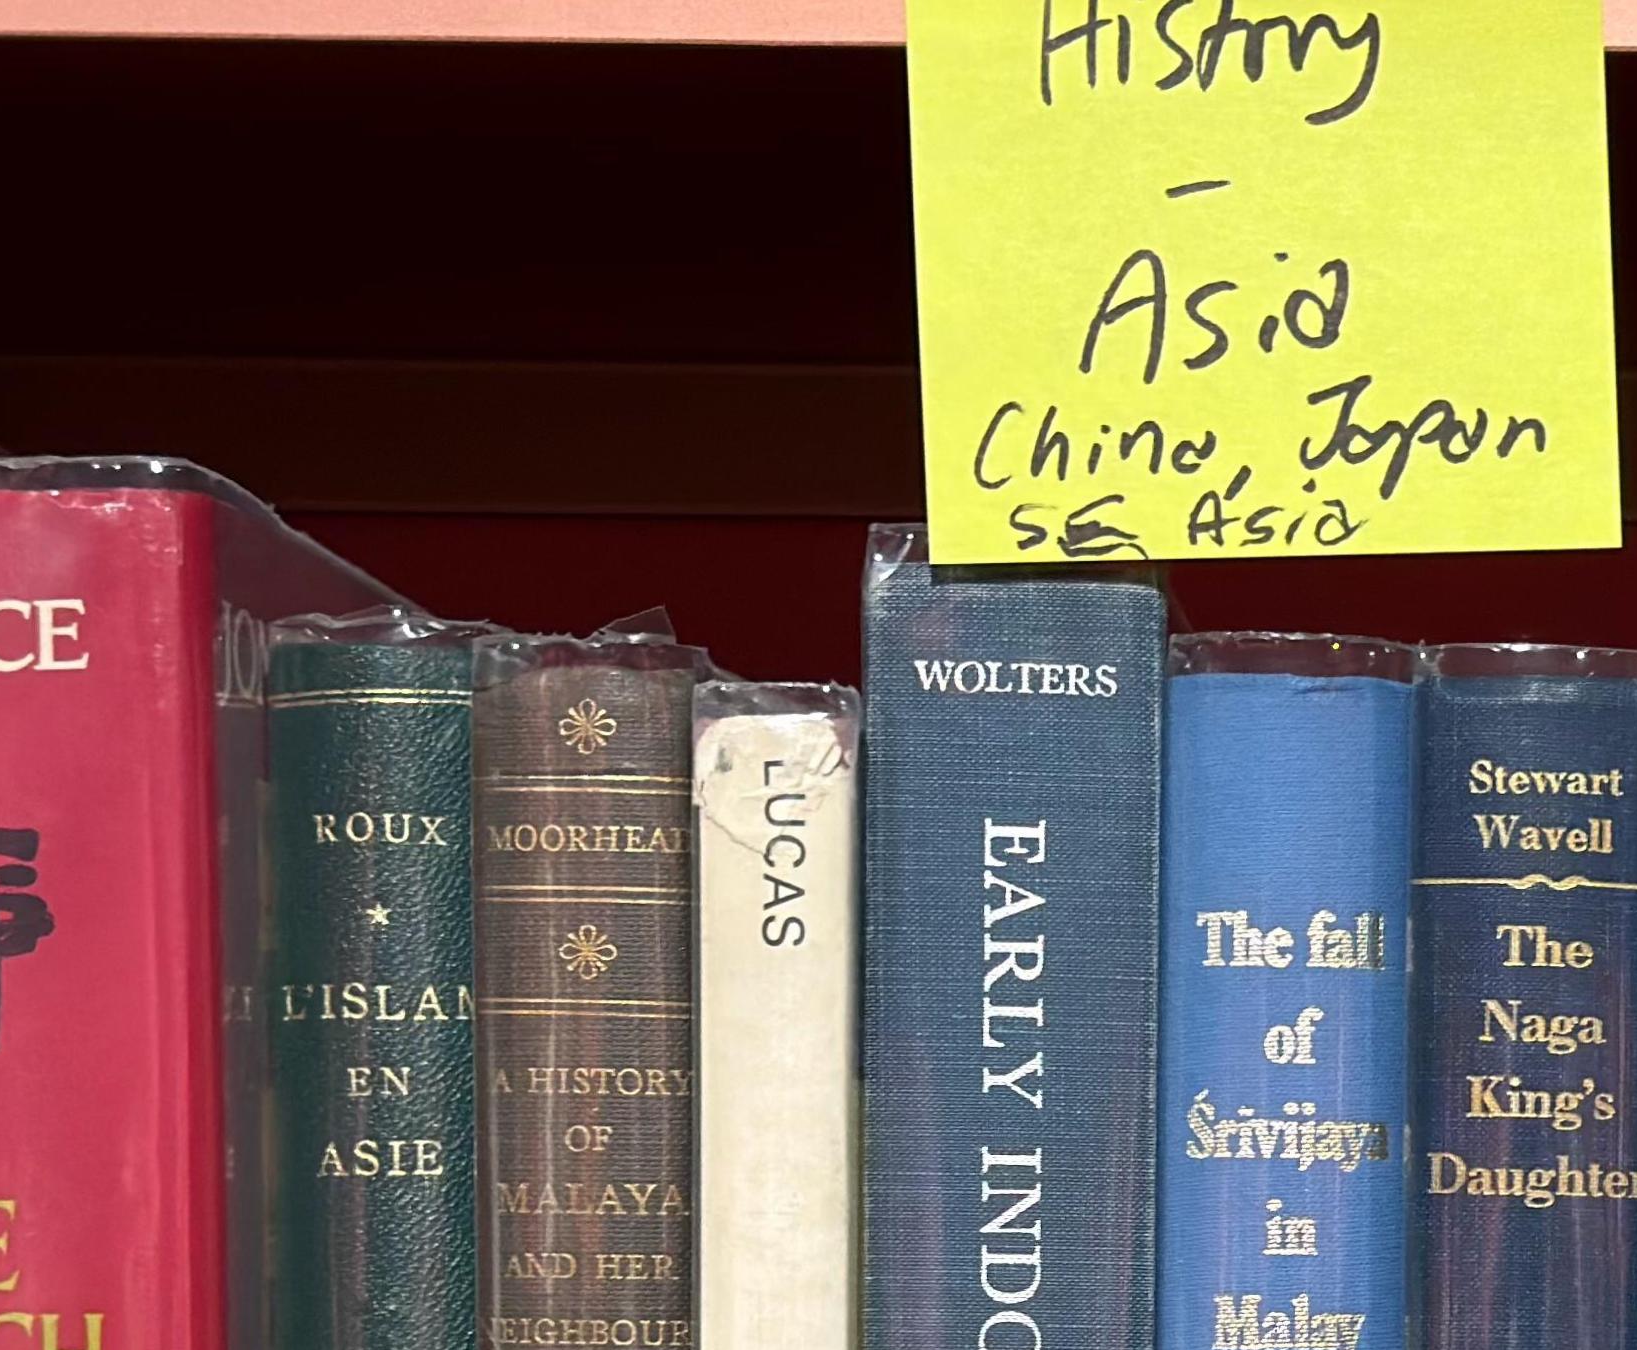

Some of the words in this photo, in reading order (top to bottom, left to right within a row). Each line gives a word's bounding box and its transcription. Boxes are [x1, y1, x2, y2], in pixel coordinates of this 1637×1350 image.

[1039, 0, 1381, 125] History
[1078, 249, 1349, 384] Asia
[1299, 375, 1547, 499] Japan
[913, 659, 1118, 697] WOLTERS
[1469, 759, 1624, 798] Stewart
[313, 812, 448, 845] ROUX
[1474, 814, 1613, 855] Wavell
[761, 761, 805, 949] LUCAS
[1196, 910, 1294, 968] The
[1305, 910, 1386, 970] fall
[1496, 925, 1594, 969] The
[980, 818, 1047, 1109] EARLY
[1263, 1007, 1325, 1065] of
[1478, 999, 1607, 1055] Naga
[347, 1067, 411, 1097] EN
[494, 1071, 511, 1095] A
[527, 1067, 692, 1097] HISTORY
[1466, 1074, 1615, 1131] King's
[317, 1140, 444, 1177] ASIE
[564, 1124, 613, 1153] OF
[497, 1182, 690, 1216] MALAYA
[1263, 1199, 1318, 1256] in
[504, 1252, 576, 1280] AND
[596, 1253, 679, 1281] HER
